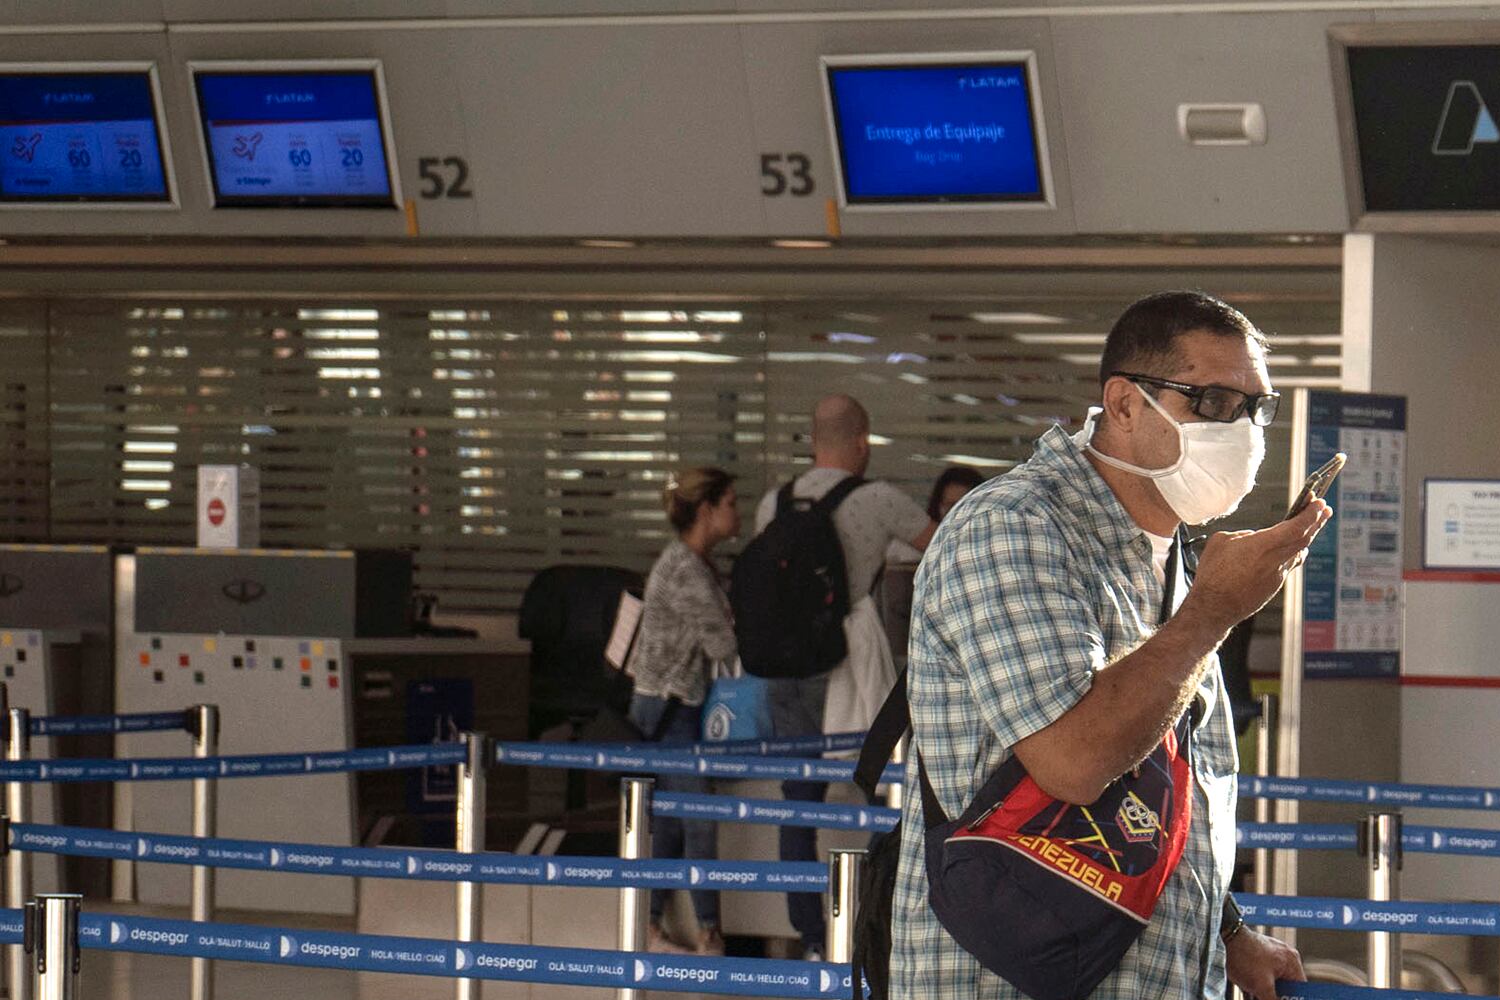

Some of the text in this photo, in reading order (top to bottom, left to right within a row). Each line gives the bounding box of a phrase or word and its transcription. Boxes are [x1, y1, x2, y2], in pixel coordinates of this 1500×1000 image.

[865, 122, 1006, 145] Entrega de Equipaje
[67, 148, 143, 168] 60 20
[287, 148, 365, 168] 60 20
[418, 155, 473, 200] 52
[760, 153, 815, 197] 53
[564, 866, 615, 881] despegar
[707, 871, 759, 884] despegar
[1363, 910, 1419, 926] despegar
[130, 927, 190, 945] despegar
[300, 941, 361, 959] despegar
[476, 954, 538, 971] despegar
[655, 965, 720, 982] despegar
